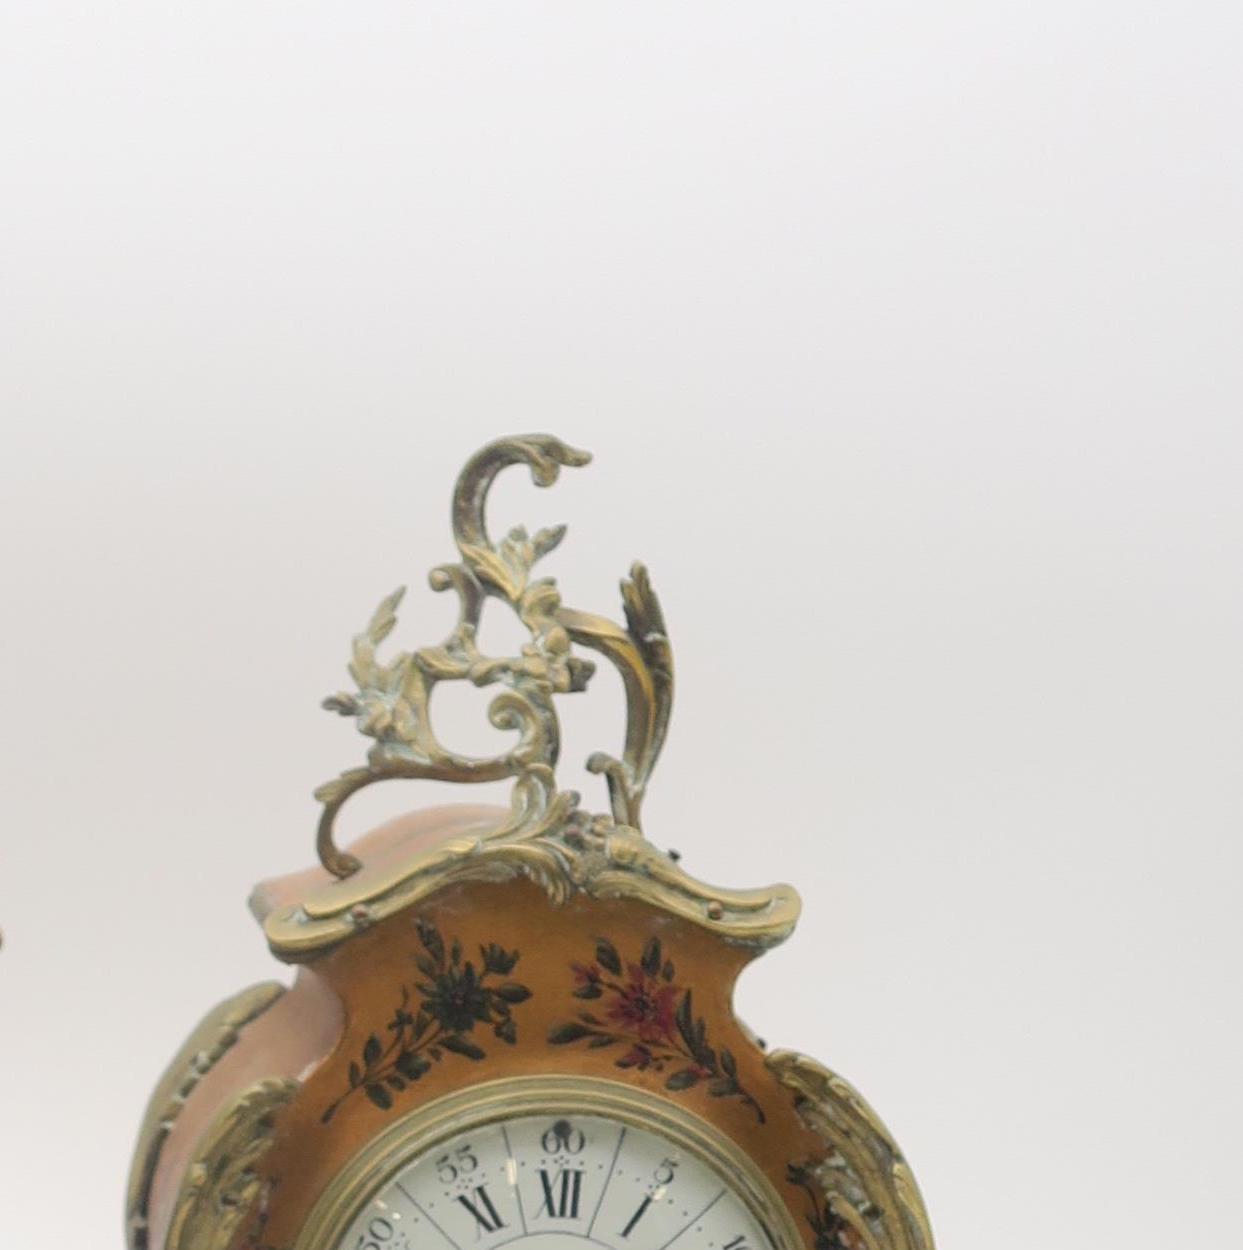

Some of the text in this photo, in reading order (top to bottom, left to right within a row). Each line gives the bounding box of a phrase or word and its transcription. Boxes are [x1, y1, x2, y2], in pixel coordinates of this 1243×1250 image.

[541, 1126, 586, 1155] 60
[436, 1144, 479, 1185] 55
[654, 1152, 679, 1185] 5
[454, 1182, 510, 1242] XI
[533, 1168, 586, 1220] XII
[619, 1195, 655, 1239] I
